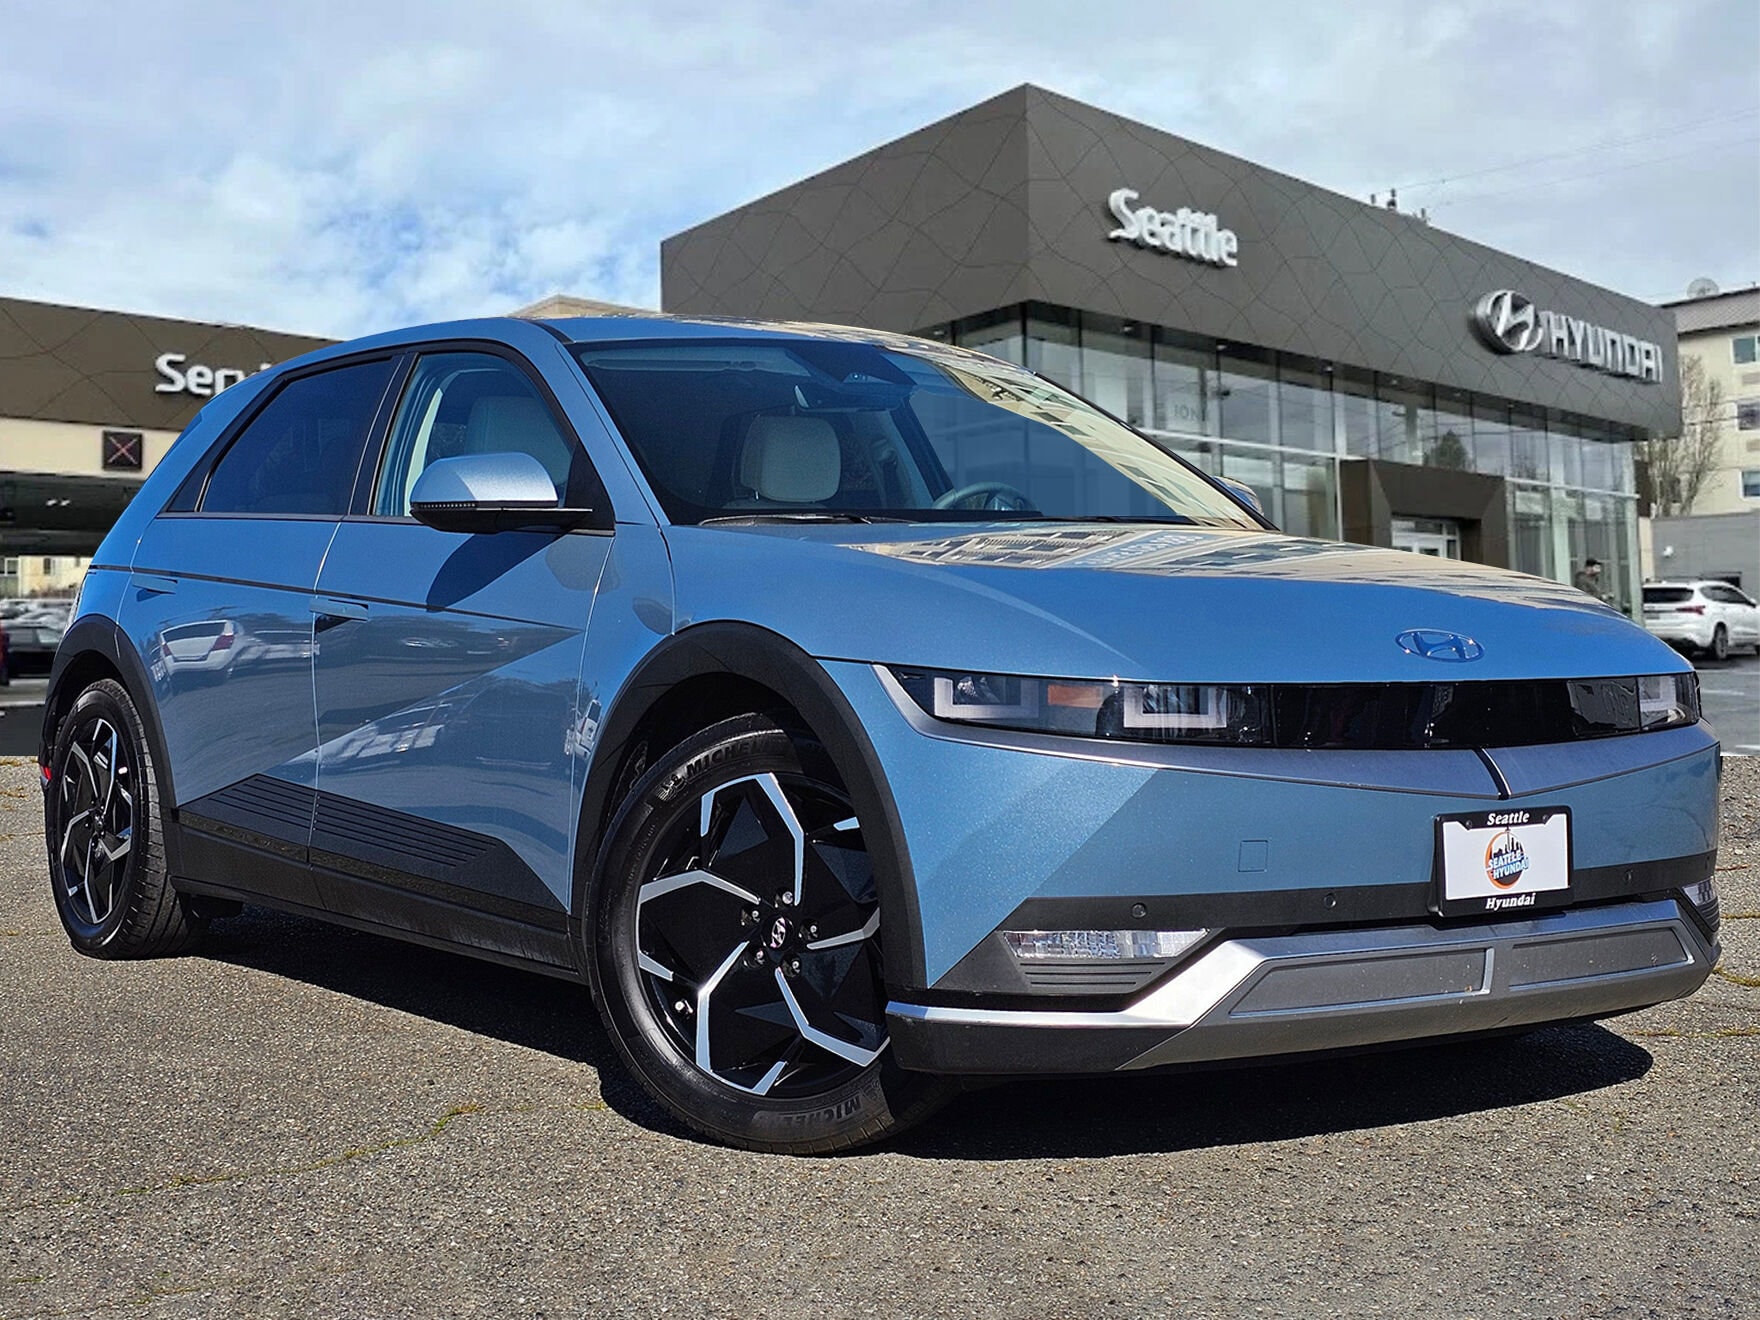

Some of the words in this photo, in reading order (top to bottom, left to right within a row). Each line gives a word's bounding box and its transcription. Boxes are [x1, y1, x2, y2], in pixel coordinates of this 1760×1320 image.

[1108, 188, 1238, 267] Seattle
[1539, 310, 1663, 382] HYUNDAI
[1487, 811, 1530, 825] Seattle
[1488, 850, 1523, 870] SEATTLE
[1485, 893, 1536, 910] Hyundai
